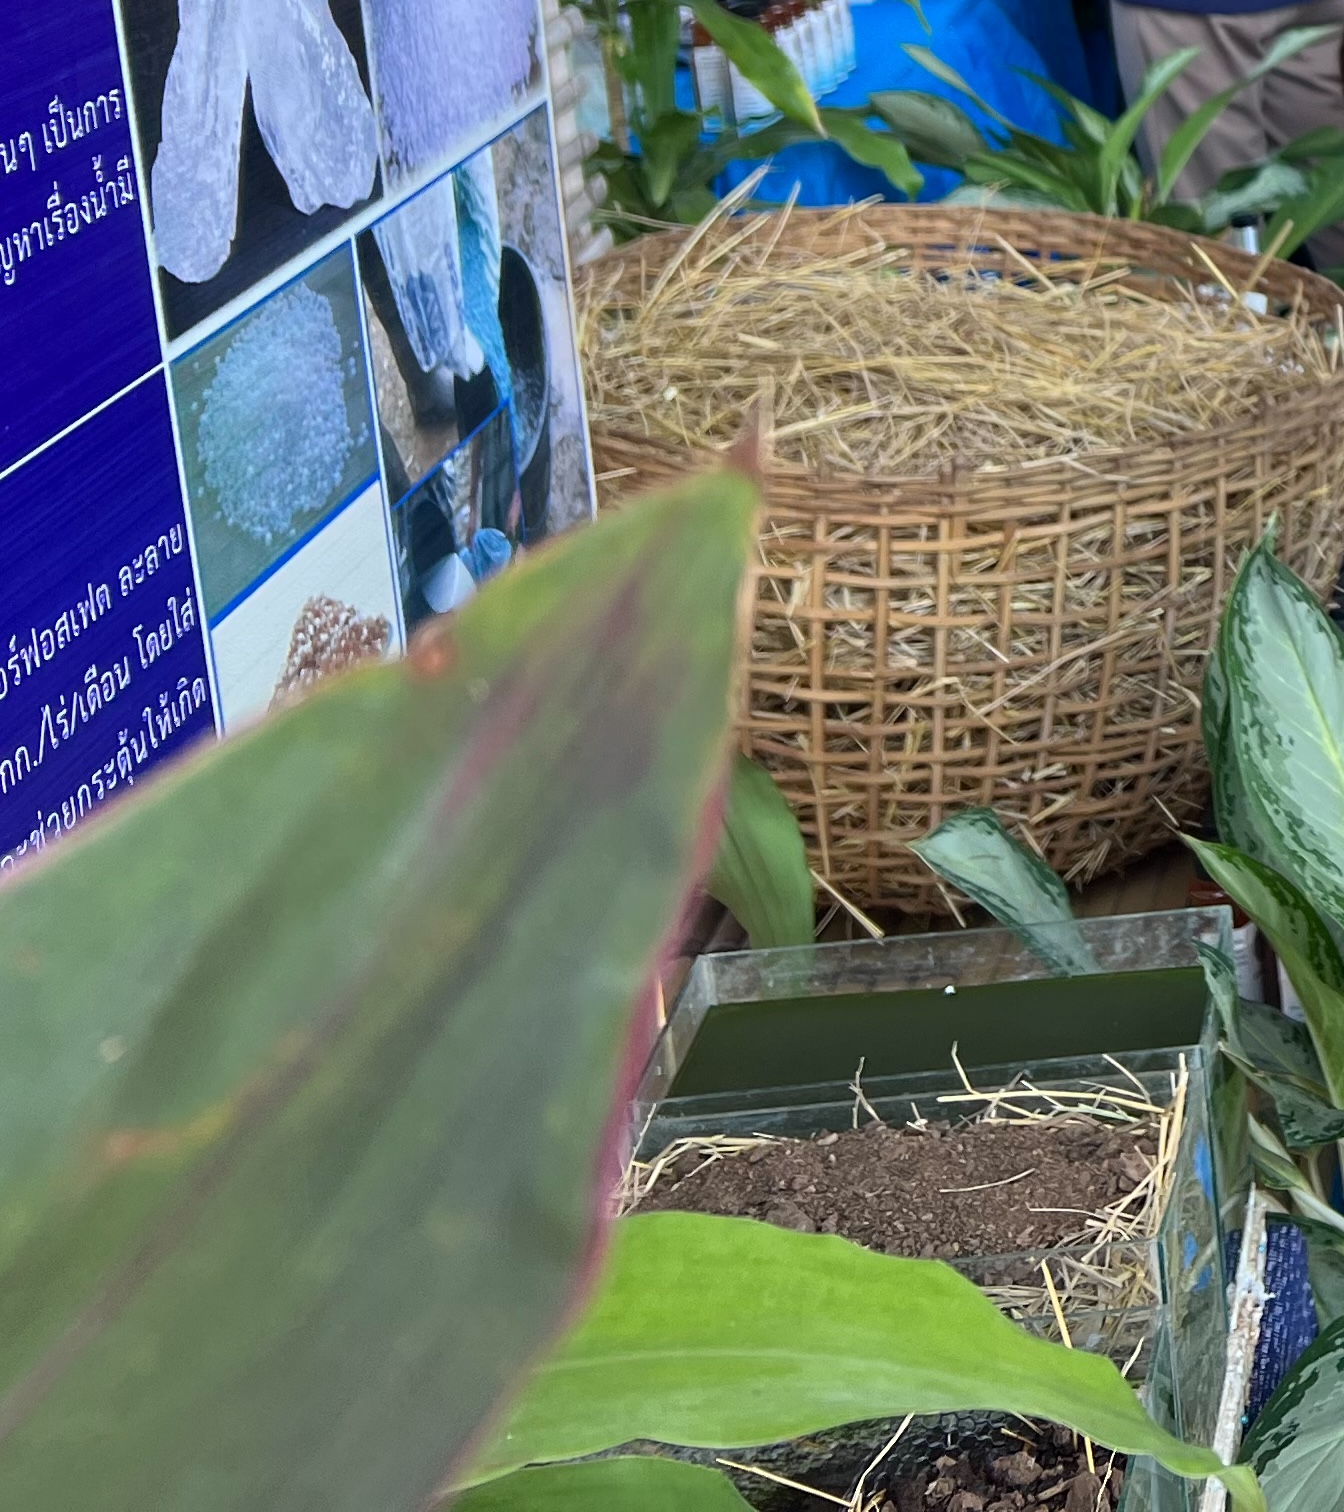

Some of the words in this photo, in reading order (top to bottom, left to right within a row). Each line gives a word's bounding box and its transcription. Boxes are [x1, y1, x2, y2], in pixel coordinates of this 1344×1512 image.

[41, 88, 122, 154] เป็นการ
[118, 523, 184, 597] ละลาย
[132, 586, 196, 670] โดยใส่
